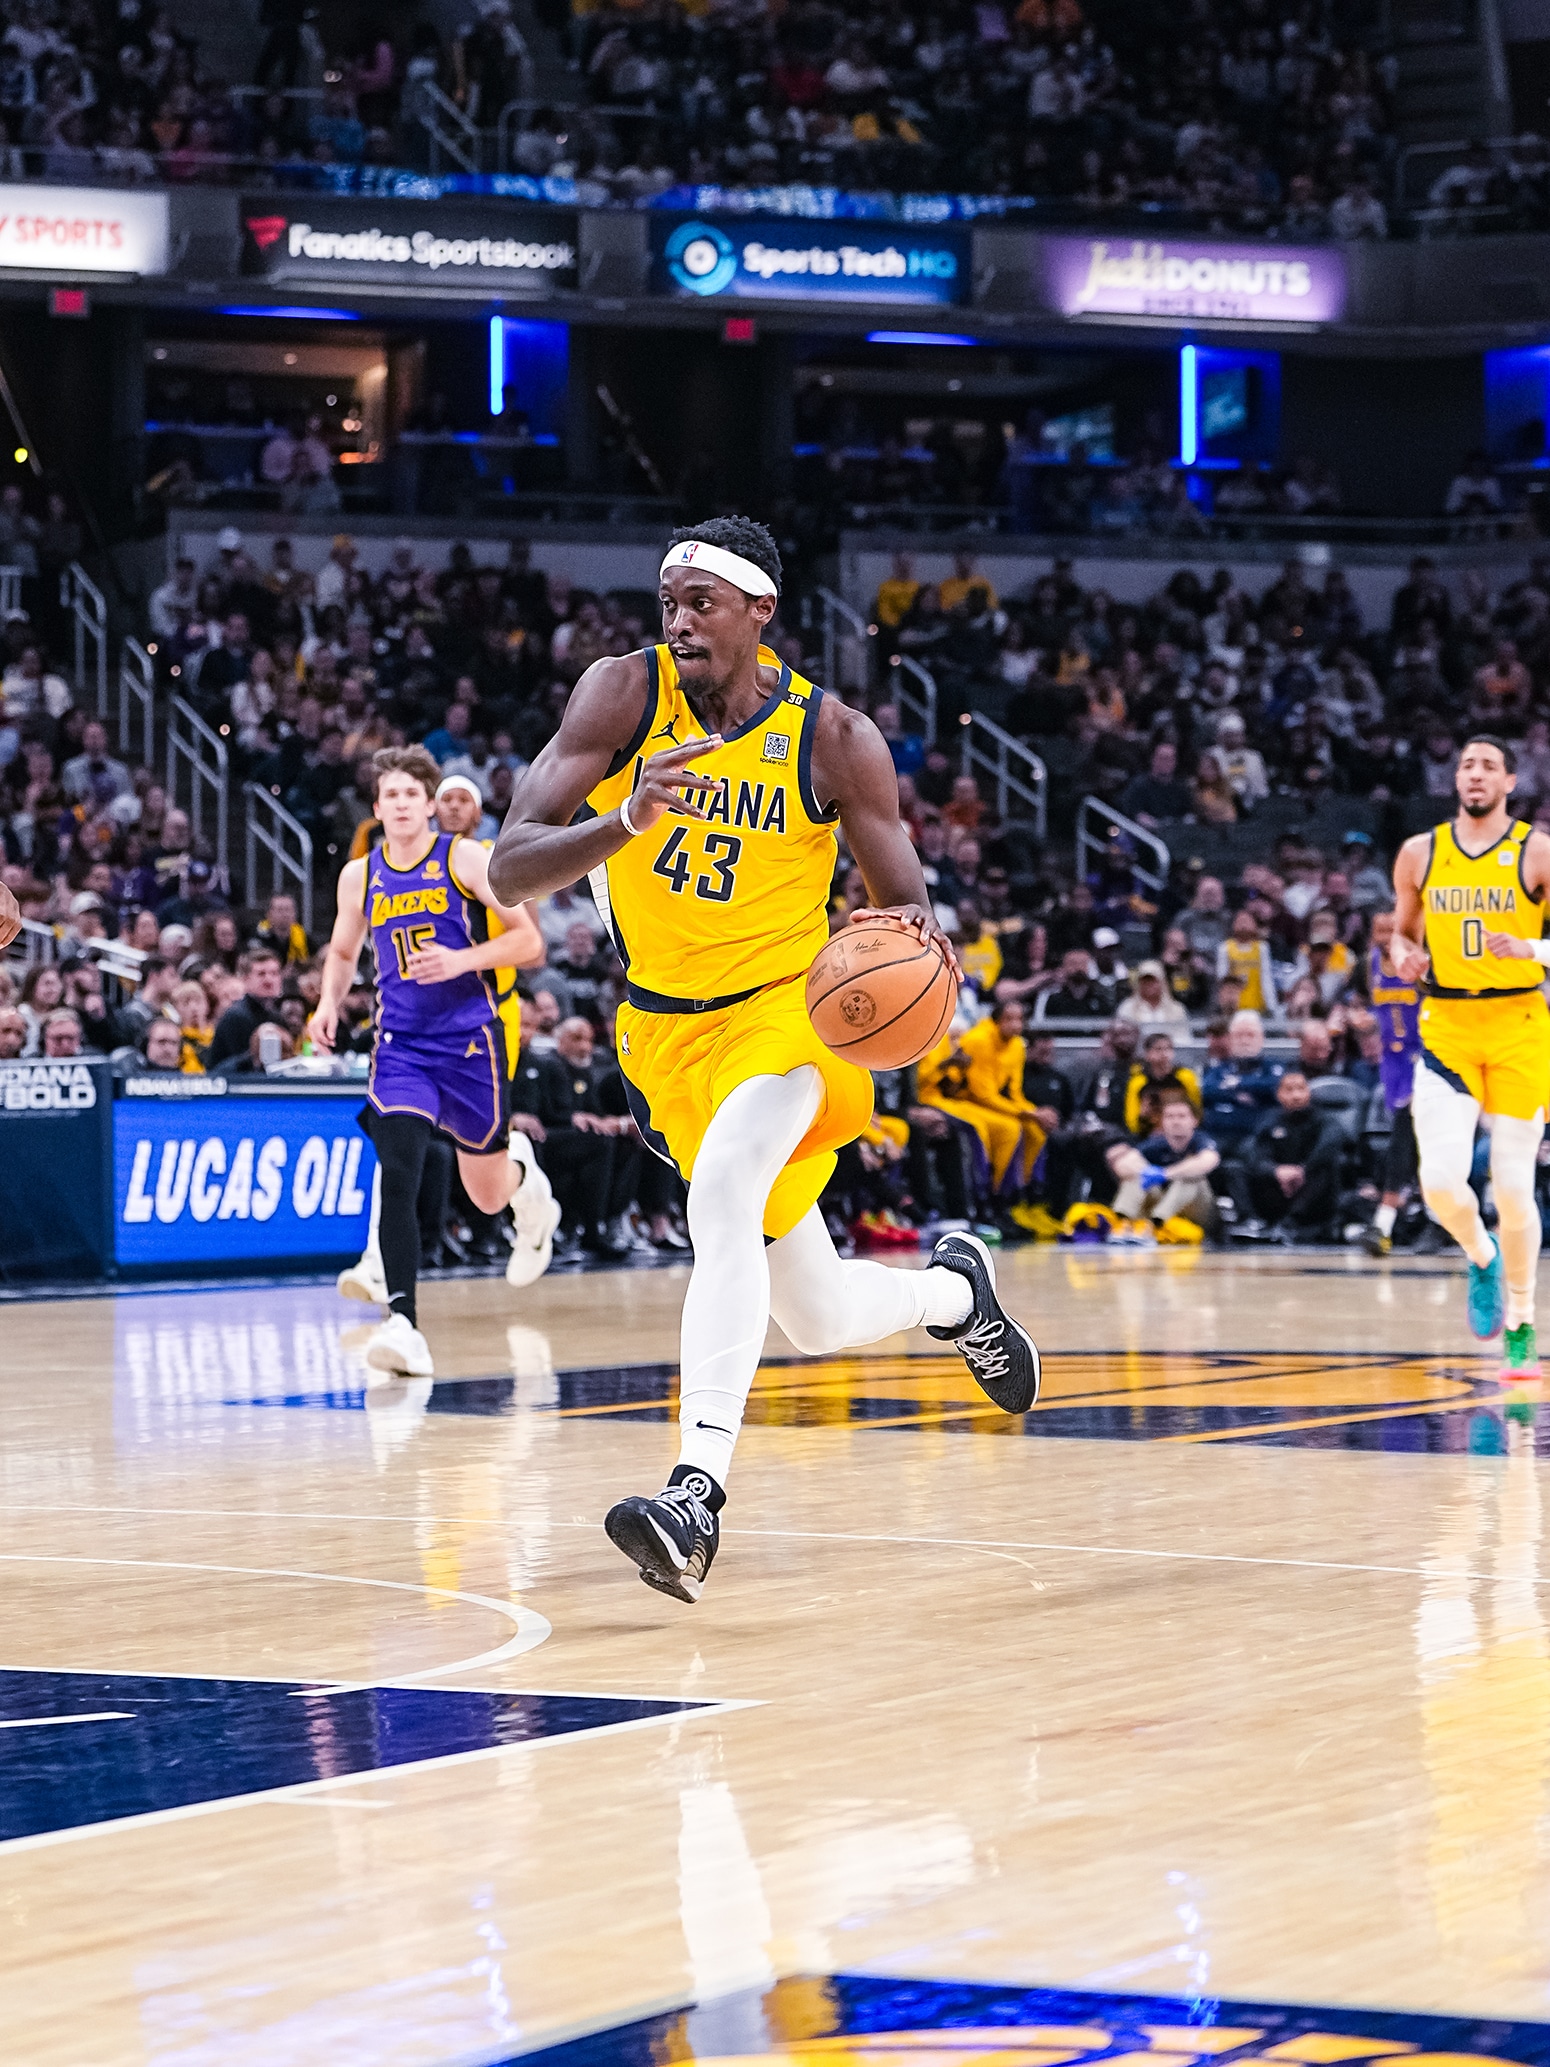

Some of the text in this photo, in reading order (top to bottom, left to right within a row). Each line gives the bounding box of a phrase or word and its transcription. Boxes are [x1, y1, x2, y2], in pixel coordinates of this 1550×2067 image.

[15, 214, 123, 248] SPORTS
[289, 223, 574, 269] Fanatics Sportsbook
[743, 242, 840, 278] Sports
[838, 246, 907, 277] Tech
[1164, 257, 1312, 297] DONUTS
[787, 694, 804, 705] 30
[631, 754, 786, 835] IDIANA
[652, 826, 742, 902] 43
[371, 887, 449, 927] LAKERS
[1428, 887, 1516, 914] INDIANA
[391, 923, 436, 980] 15
[1463, 918, 1482, 959] 0
[4, 1085, 97, 1110] BOLD
[123, 1134, 366, 1224] LUCAS OIL
